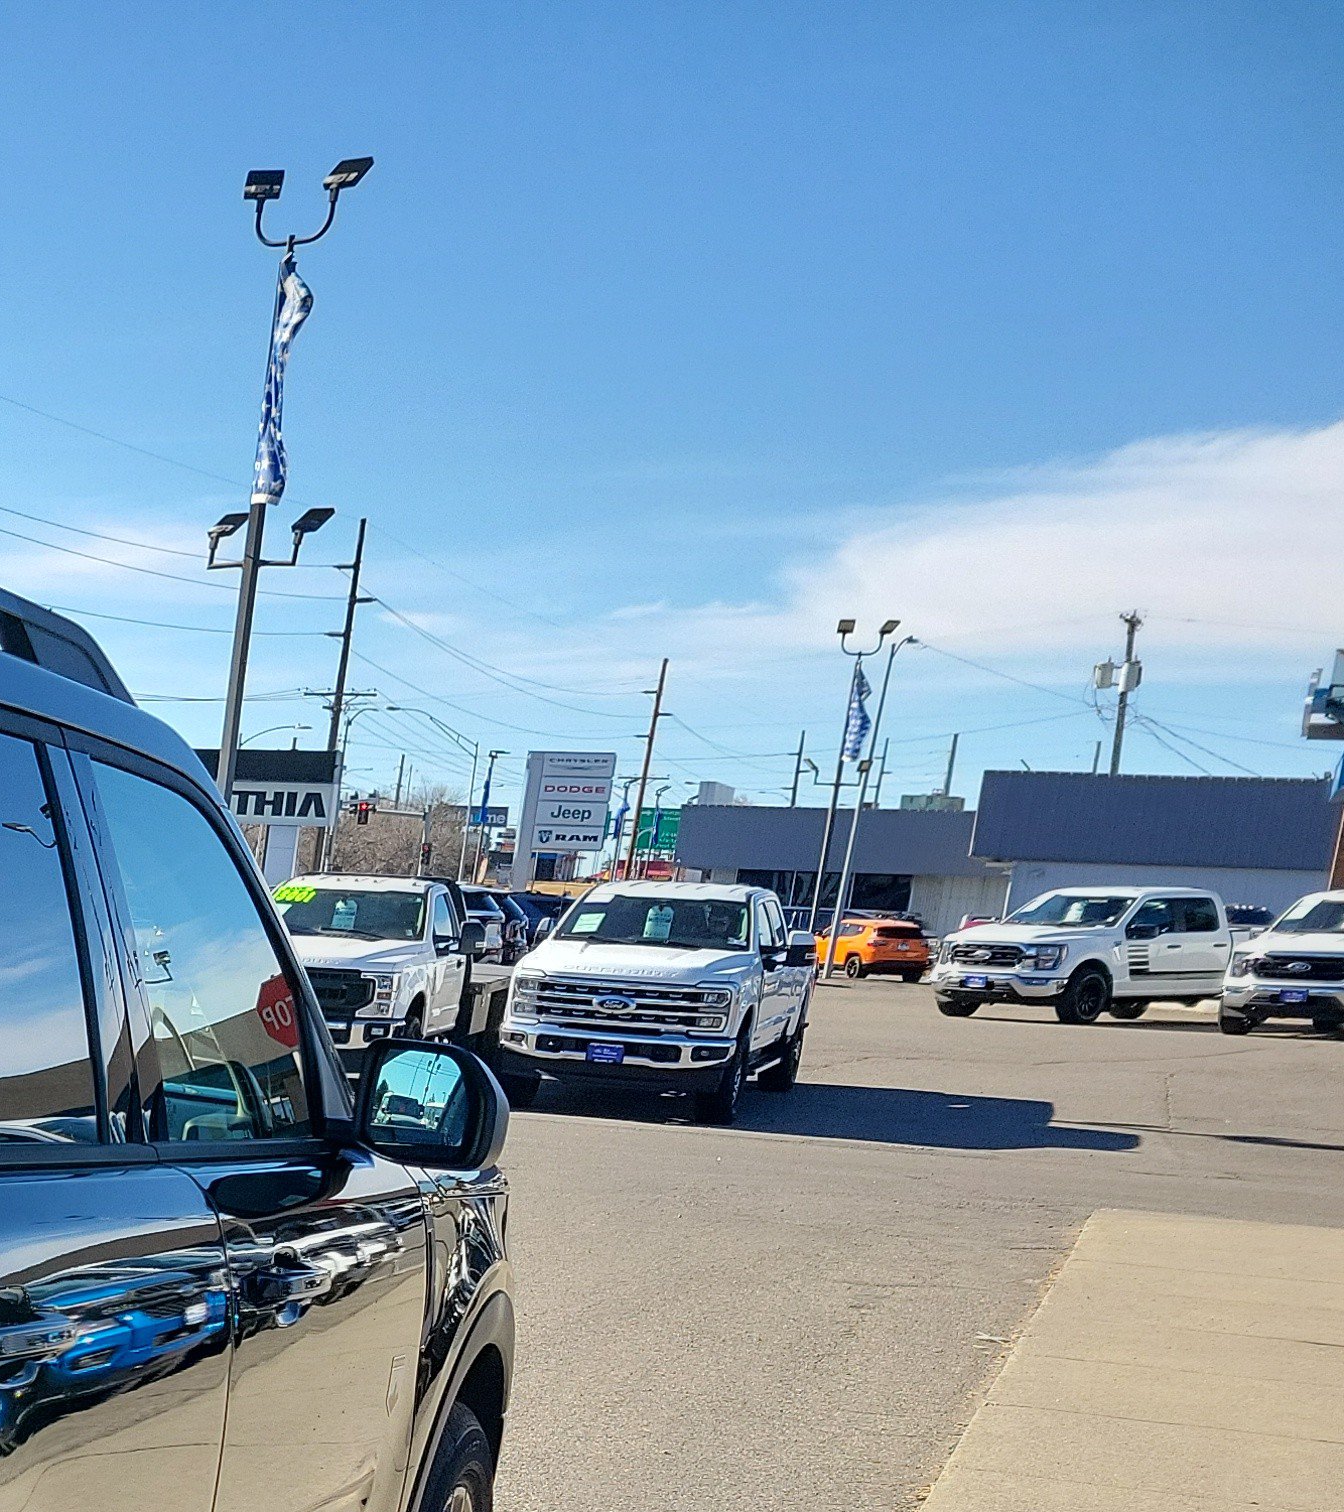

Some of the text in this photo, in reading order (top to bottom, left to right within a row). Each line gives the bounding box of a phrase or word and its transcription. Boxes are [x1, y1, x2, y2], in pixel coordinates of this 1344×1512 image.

[544, 785, 606, 794] DODGE
[551, 805, 592, 822] Jeep
[554, 833, 599, 842] RAM
